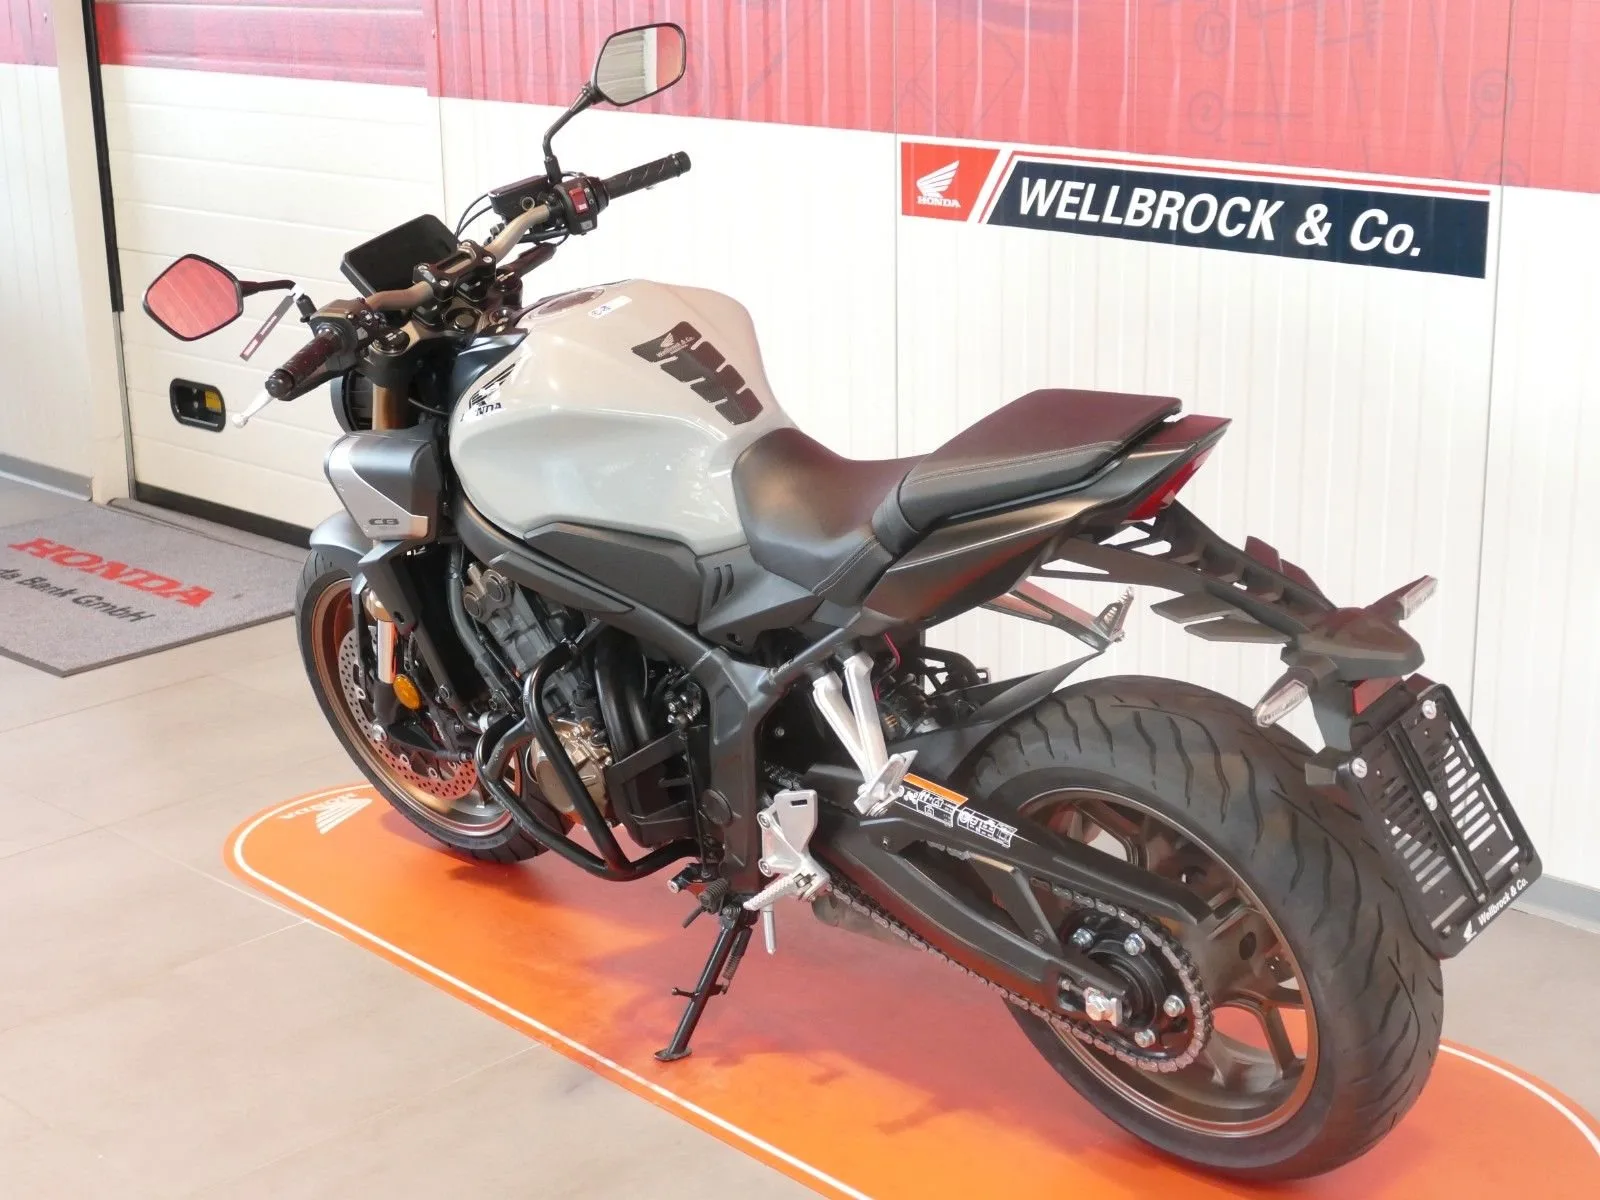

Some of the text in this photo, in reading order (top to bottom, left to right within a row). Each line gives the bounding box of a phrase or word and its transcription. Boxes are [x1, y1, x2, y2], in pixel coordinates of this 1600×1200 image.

[917, 195, 961, 209] HONDA
[1018, 177, 1422, 257] WELLBROCK & Co.
[368, 518, 400, 526] CB
[8, 537, 215, 608] HONDA
[16, 576, 77, 598] Bank
[72, 594, 156, 622] GmbH
[1477, 878, 1528, 926] Wellbrock & Co.
